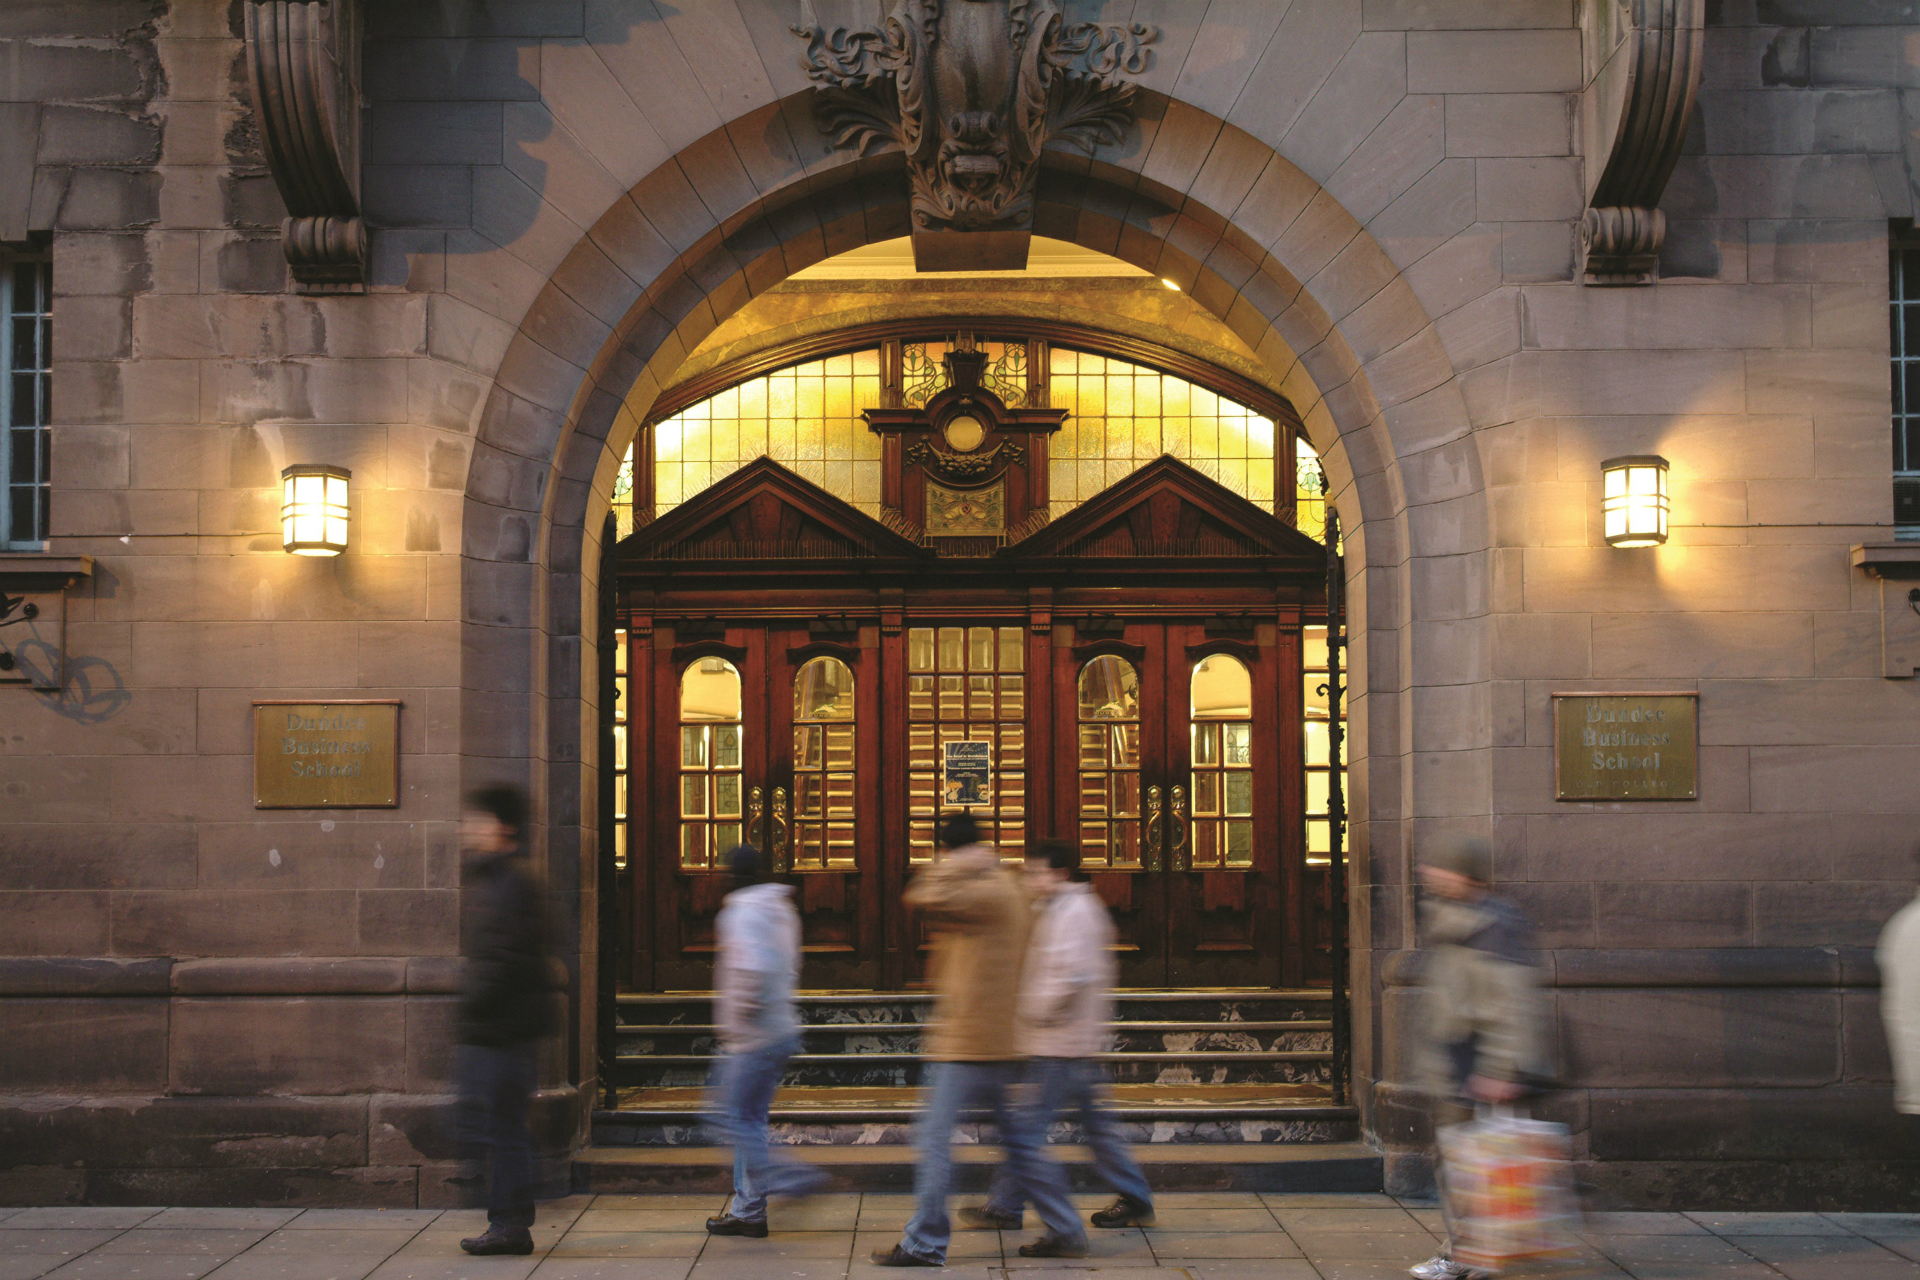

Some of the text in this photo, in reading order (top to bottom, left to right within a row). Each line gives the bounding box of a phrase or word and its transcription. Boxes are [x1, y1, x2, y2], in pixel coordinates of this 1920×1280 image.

[287, 713, 367, 731] Dundee
[1586, 705, 1666, 723] Dundee
[281, 737, 371, 755] Business
[1583, 729, 1671, 747] Business
[291, 760, 361, 778] School
[1592, 752, 1661, 771] School
